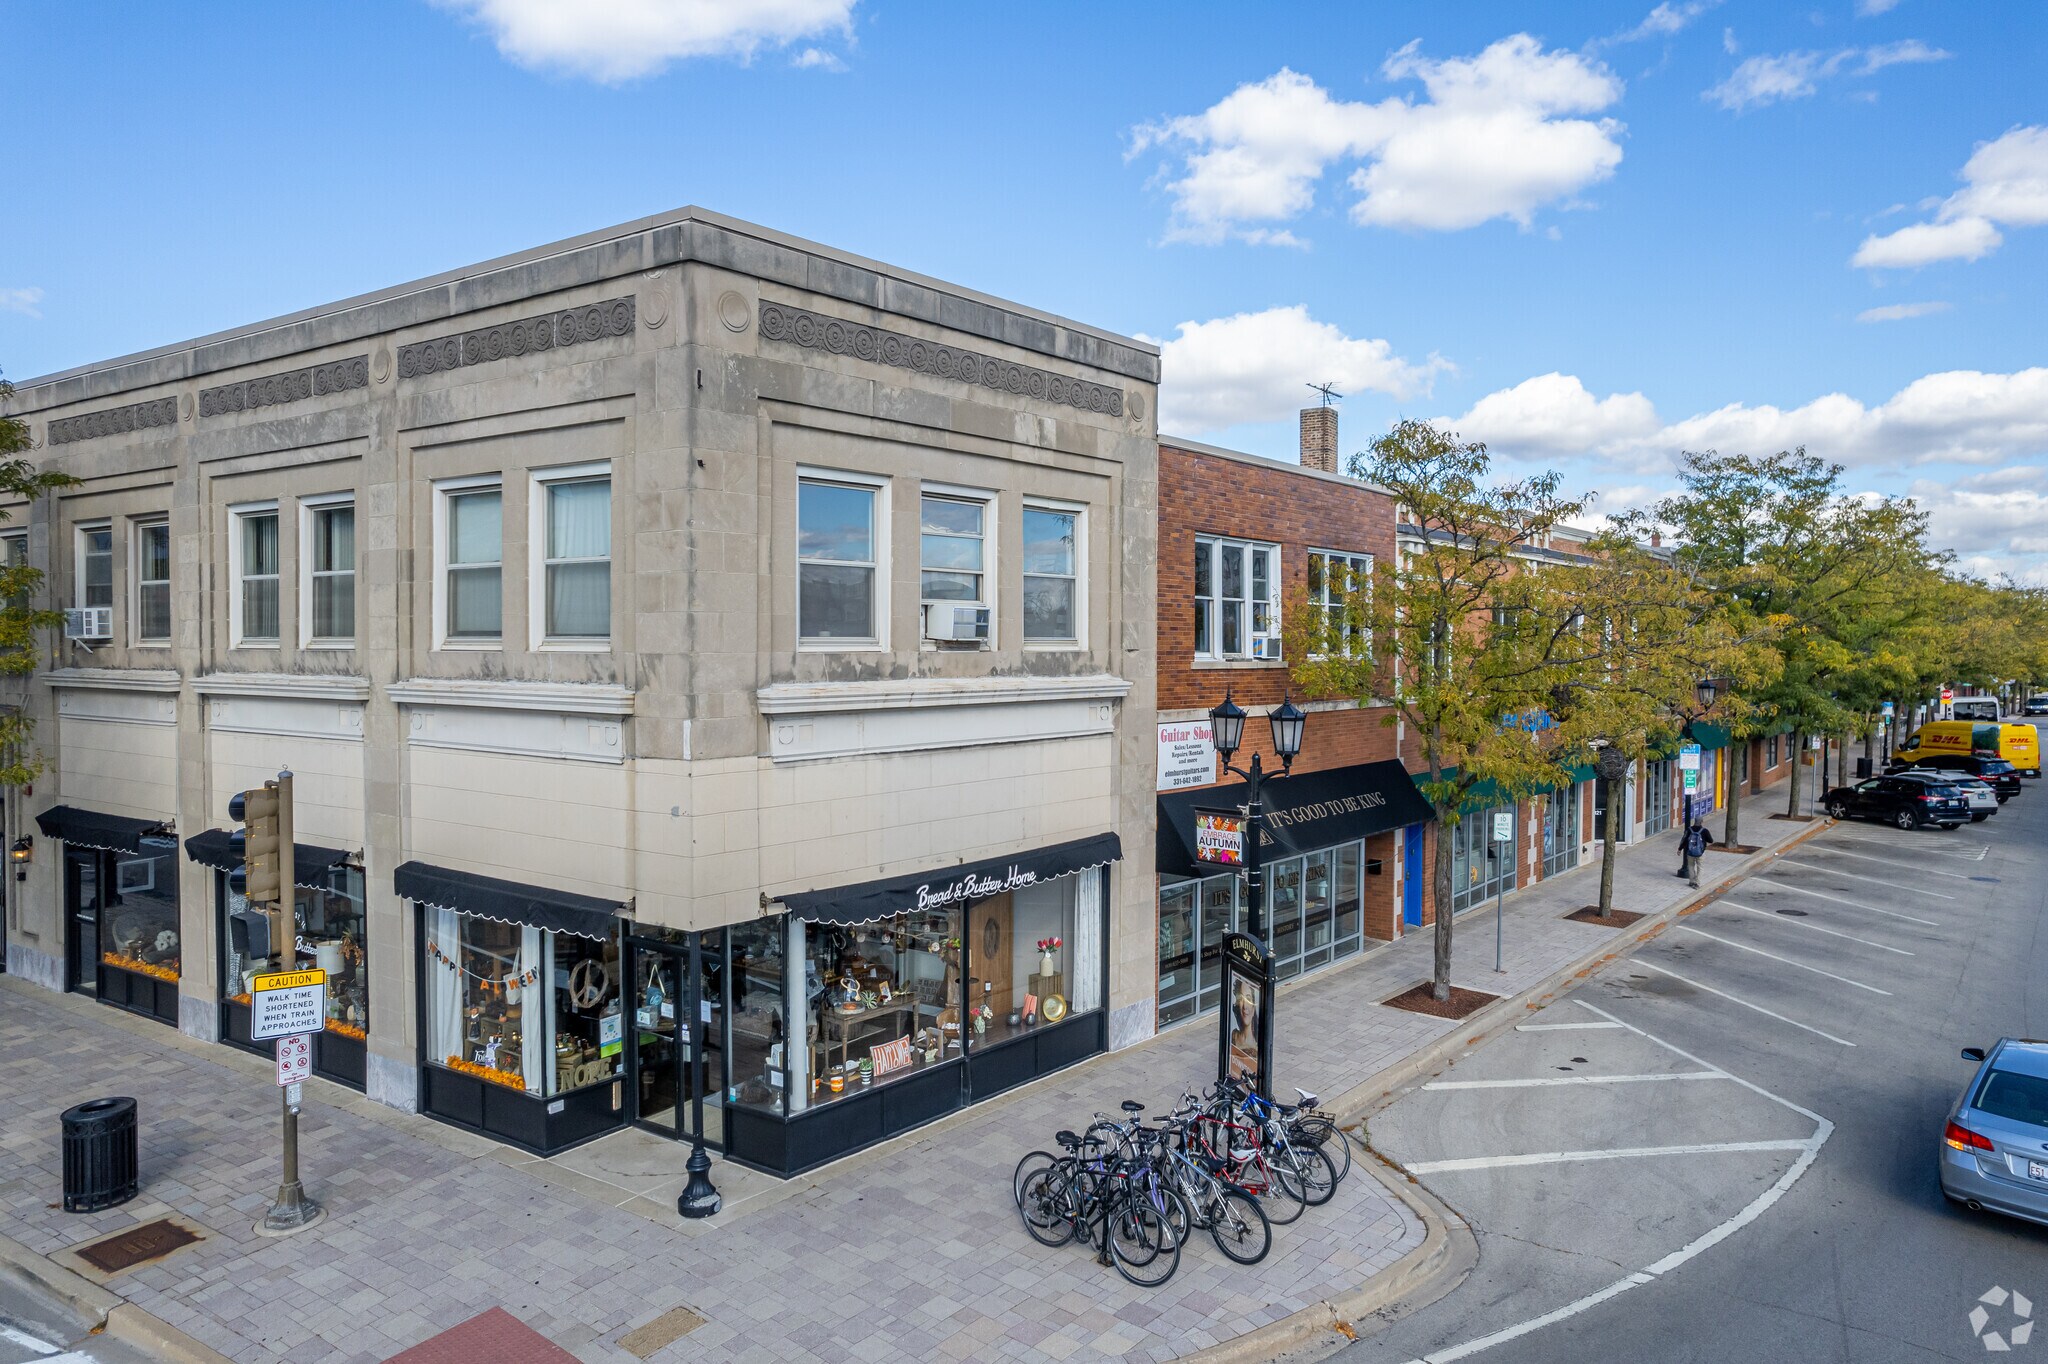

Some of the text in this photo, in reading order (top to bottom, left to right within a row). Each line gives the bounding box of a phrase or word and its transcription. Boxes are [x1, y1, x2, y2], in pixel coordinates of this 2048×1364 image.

[1161, 726, 1213, 743] Guitar Shop
[1932, 735, 1961, 745] DHL
[1164, 766, 1210, 778] elmhurstguitars.com
[1266, 791, 1386, 828] IT'S GOOD TO BE KING
[1203, 830, 1236, 841] EMBRACE
[1199, 837, 1240, 850] AUTUMN
[916, 864, 1036, 908] Bread & Butter Home
[1232, 938, 1264, 964] ELMHURST
[268, 974, 312, 988] CAUTION
[267, 991, 312, 1002] WALK TIME
[265, 1001, 314, 1013] SHORTENED
[264, 1009, 315, 1022] WHEN TRAIN
[260, 1018, 317, 1031] APPROACHES
